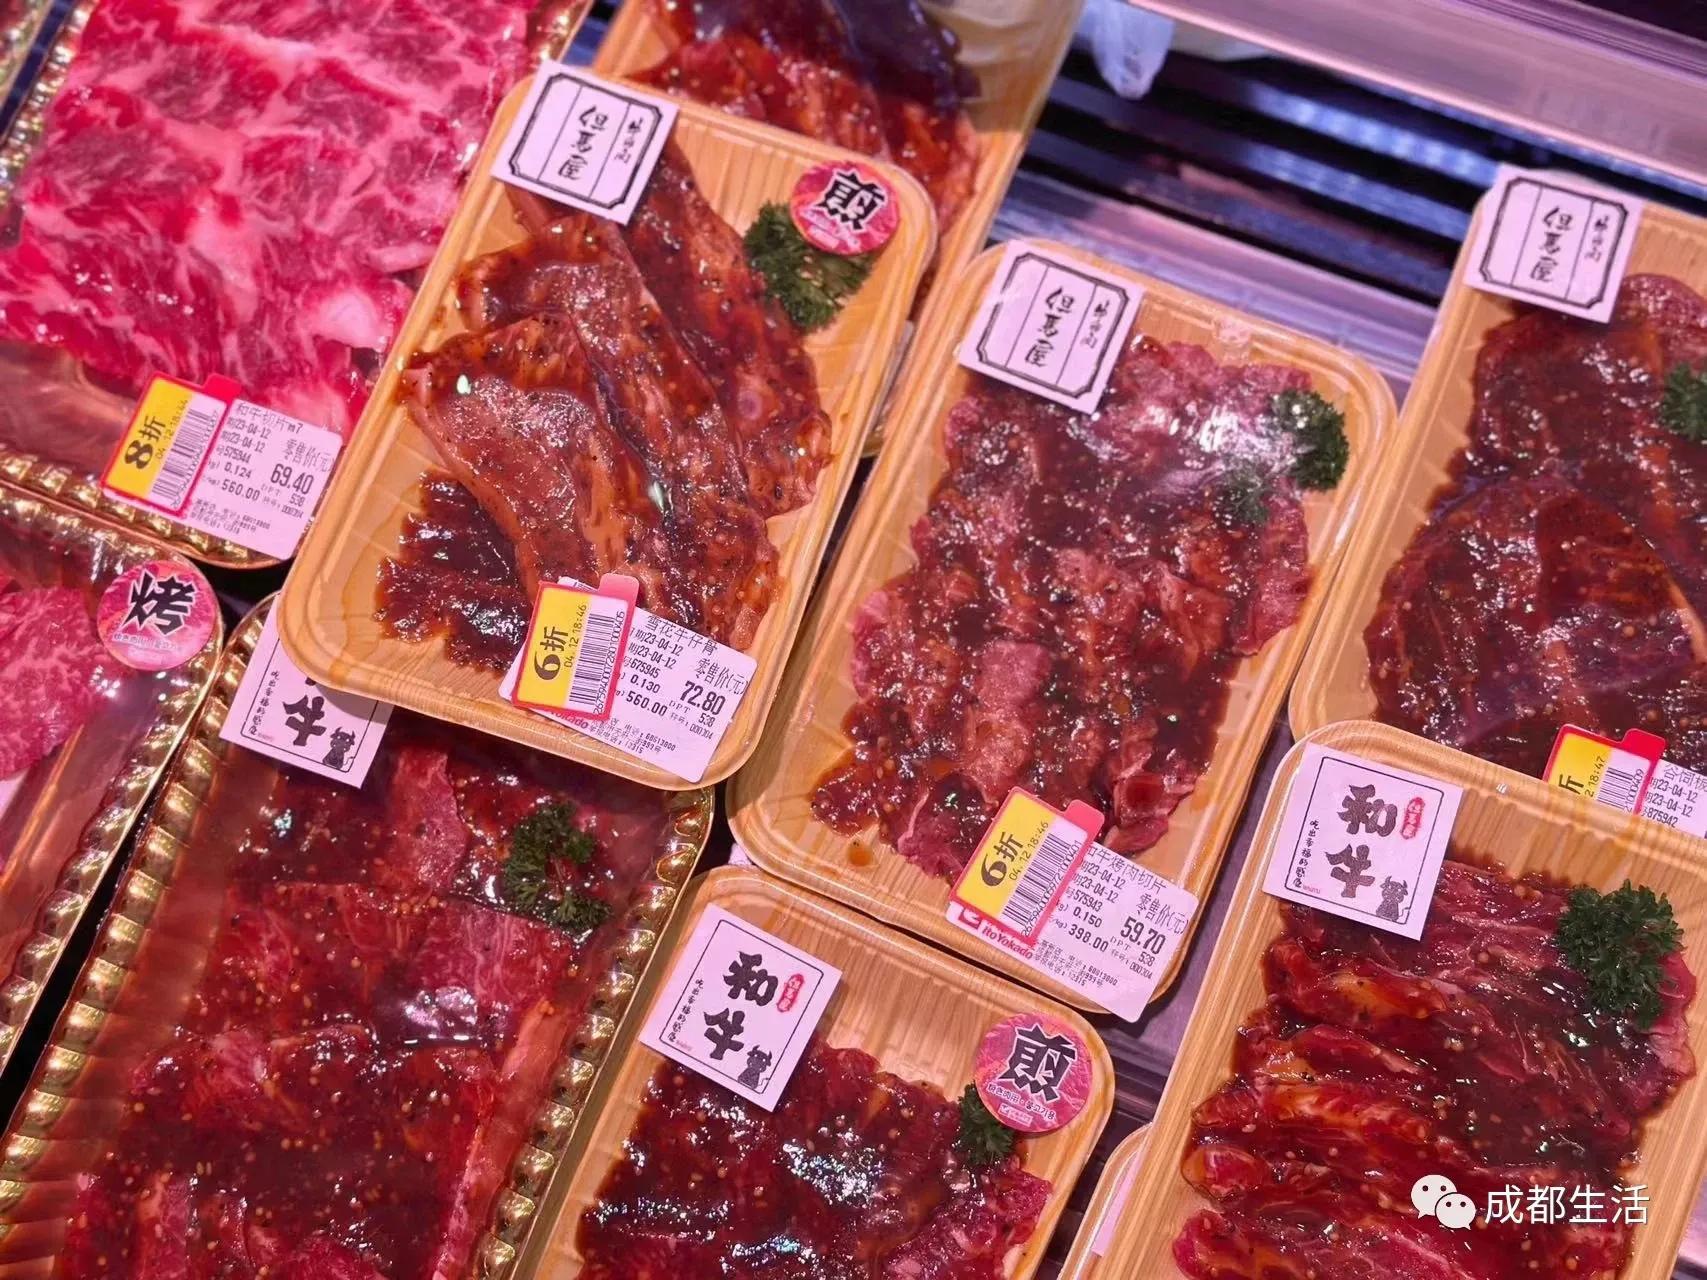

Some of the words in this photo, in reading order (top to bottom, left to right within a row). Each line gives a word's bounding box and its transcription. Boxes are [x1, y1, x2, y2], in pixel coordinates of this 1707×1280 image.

[815, 171, 885, 231] 煎
[124, 415, 166, 470] 8折
[221, 478, 261, 502] 560.00
[271, 463, 314, 495] 69.40
[123, 569, 197, 636] 烤
[533, 626, 569, 681] 6折
[630, 673, 661, 694] 0.130
[680, 680, 727, 717] 72.80
[282, 678, 327, 747] 牛
[625, 690, 668, 717] 560.00
[981, 831, 1024, 887] 6折
[1073, 906, 1102, 928] 0.150
[1120, 916, 1166, 955] 59.70
[1068, 923, 1109, 953] 398.00
[998, 1024, 1076, 1102] 煎
